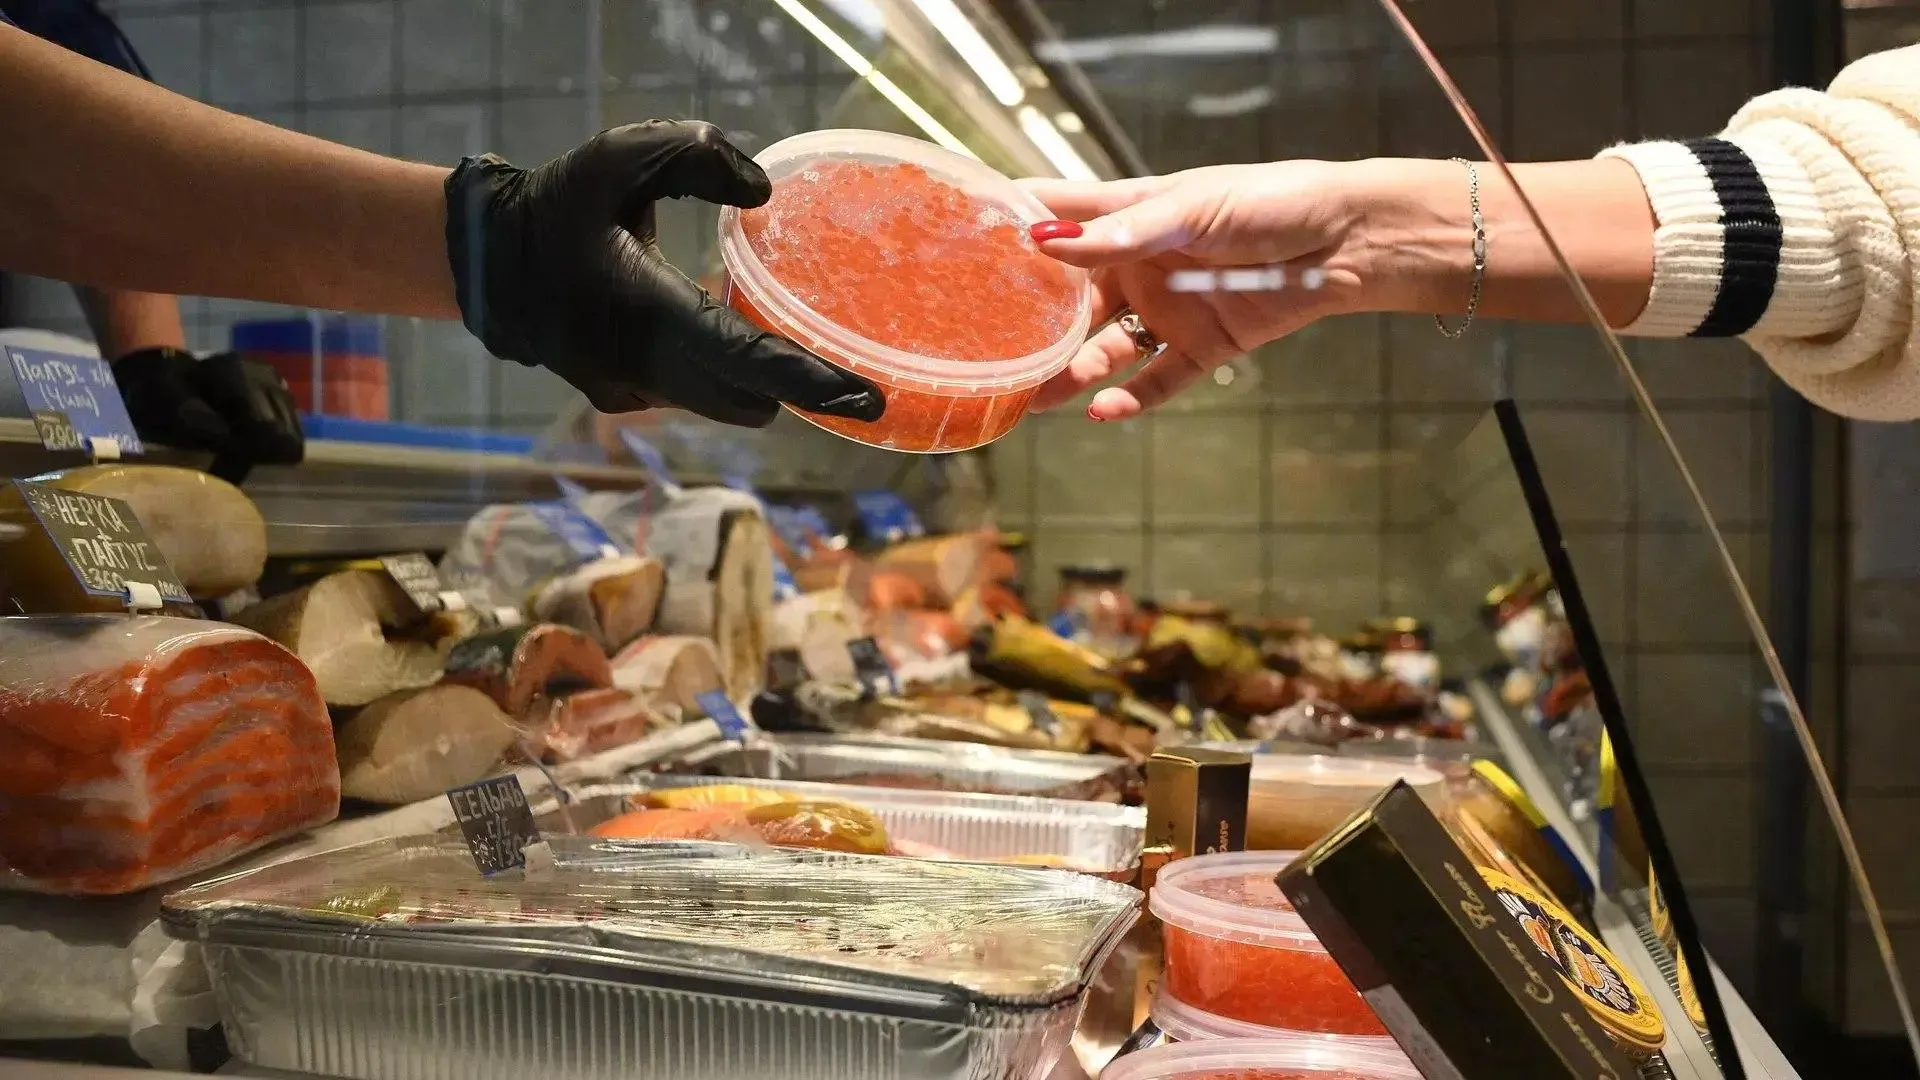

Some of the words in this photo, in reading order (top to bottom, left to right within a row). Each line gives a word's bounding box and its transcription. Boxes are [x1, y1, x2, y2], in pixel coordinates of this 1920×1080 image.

[53, 494, 130, 533] НЕРКА
[72, 537, 157, 571] ПАЛТУС
[451, 780, 524, 822] СЕЛЬДЬ
